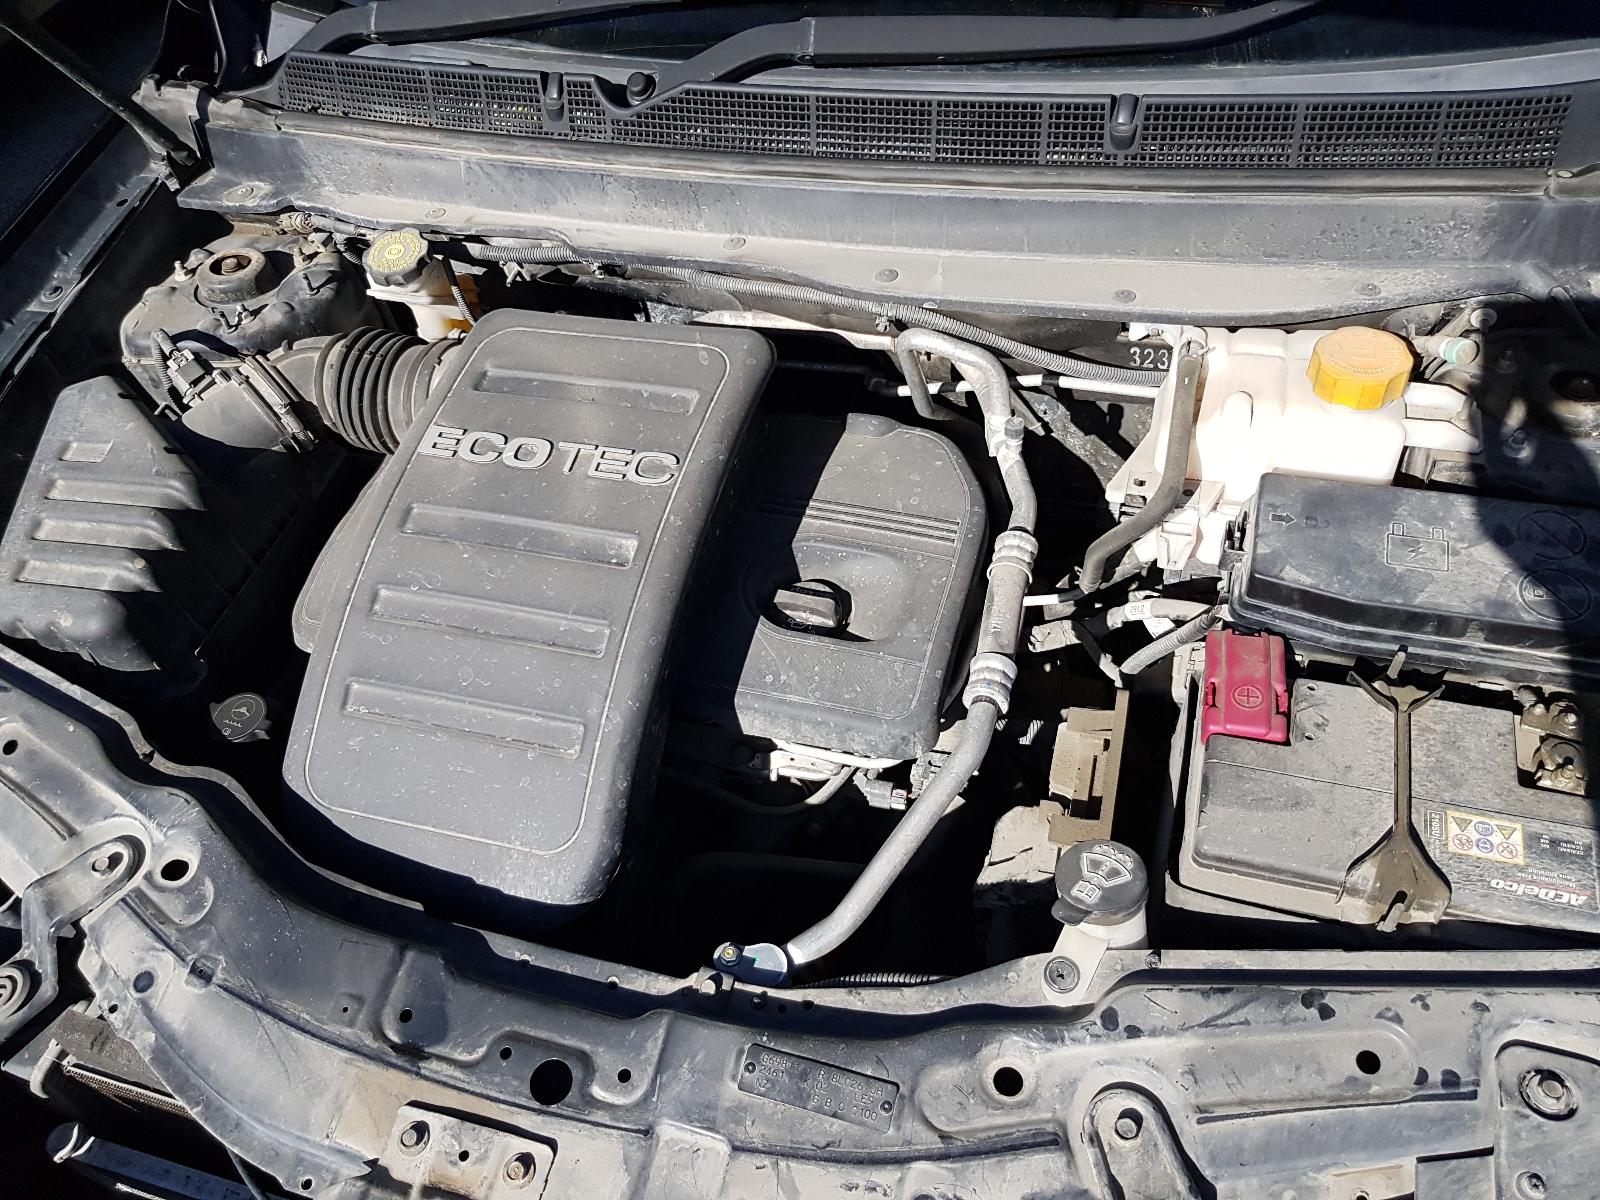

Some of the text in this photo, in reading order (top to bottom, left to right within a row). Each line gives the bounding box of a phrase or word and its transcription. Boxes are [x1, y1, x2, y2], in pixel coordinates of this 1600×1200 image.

[1129, 346, 1169, 370] 323
[419, 424, 681, 487] ECOTEC
[1490, 879, 1588, 906] ACDelco
